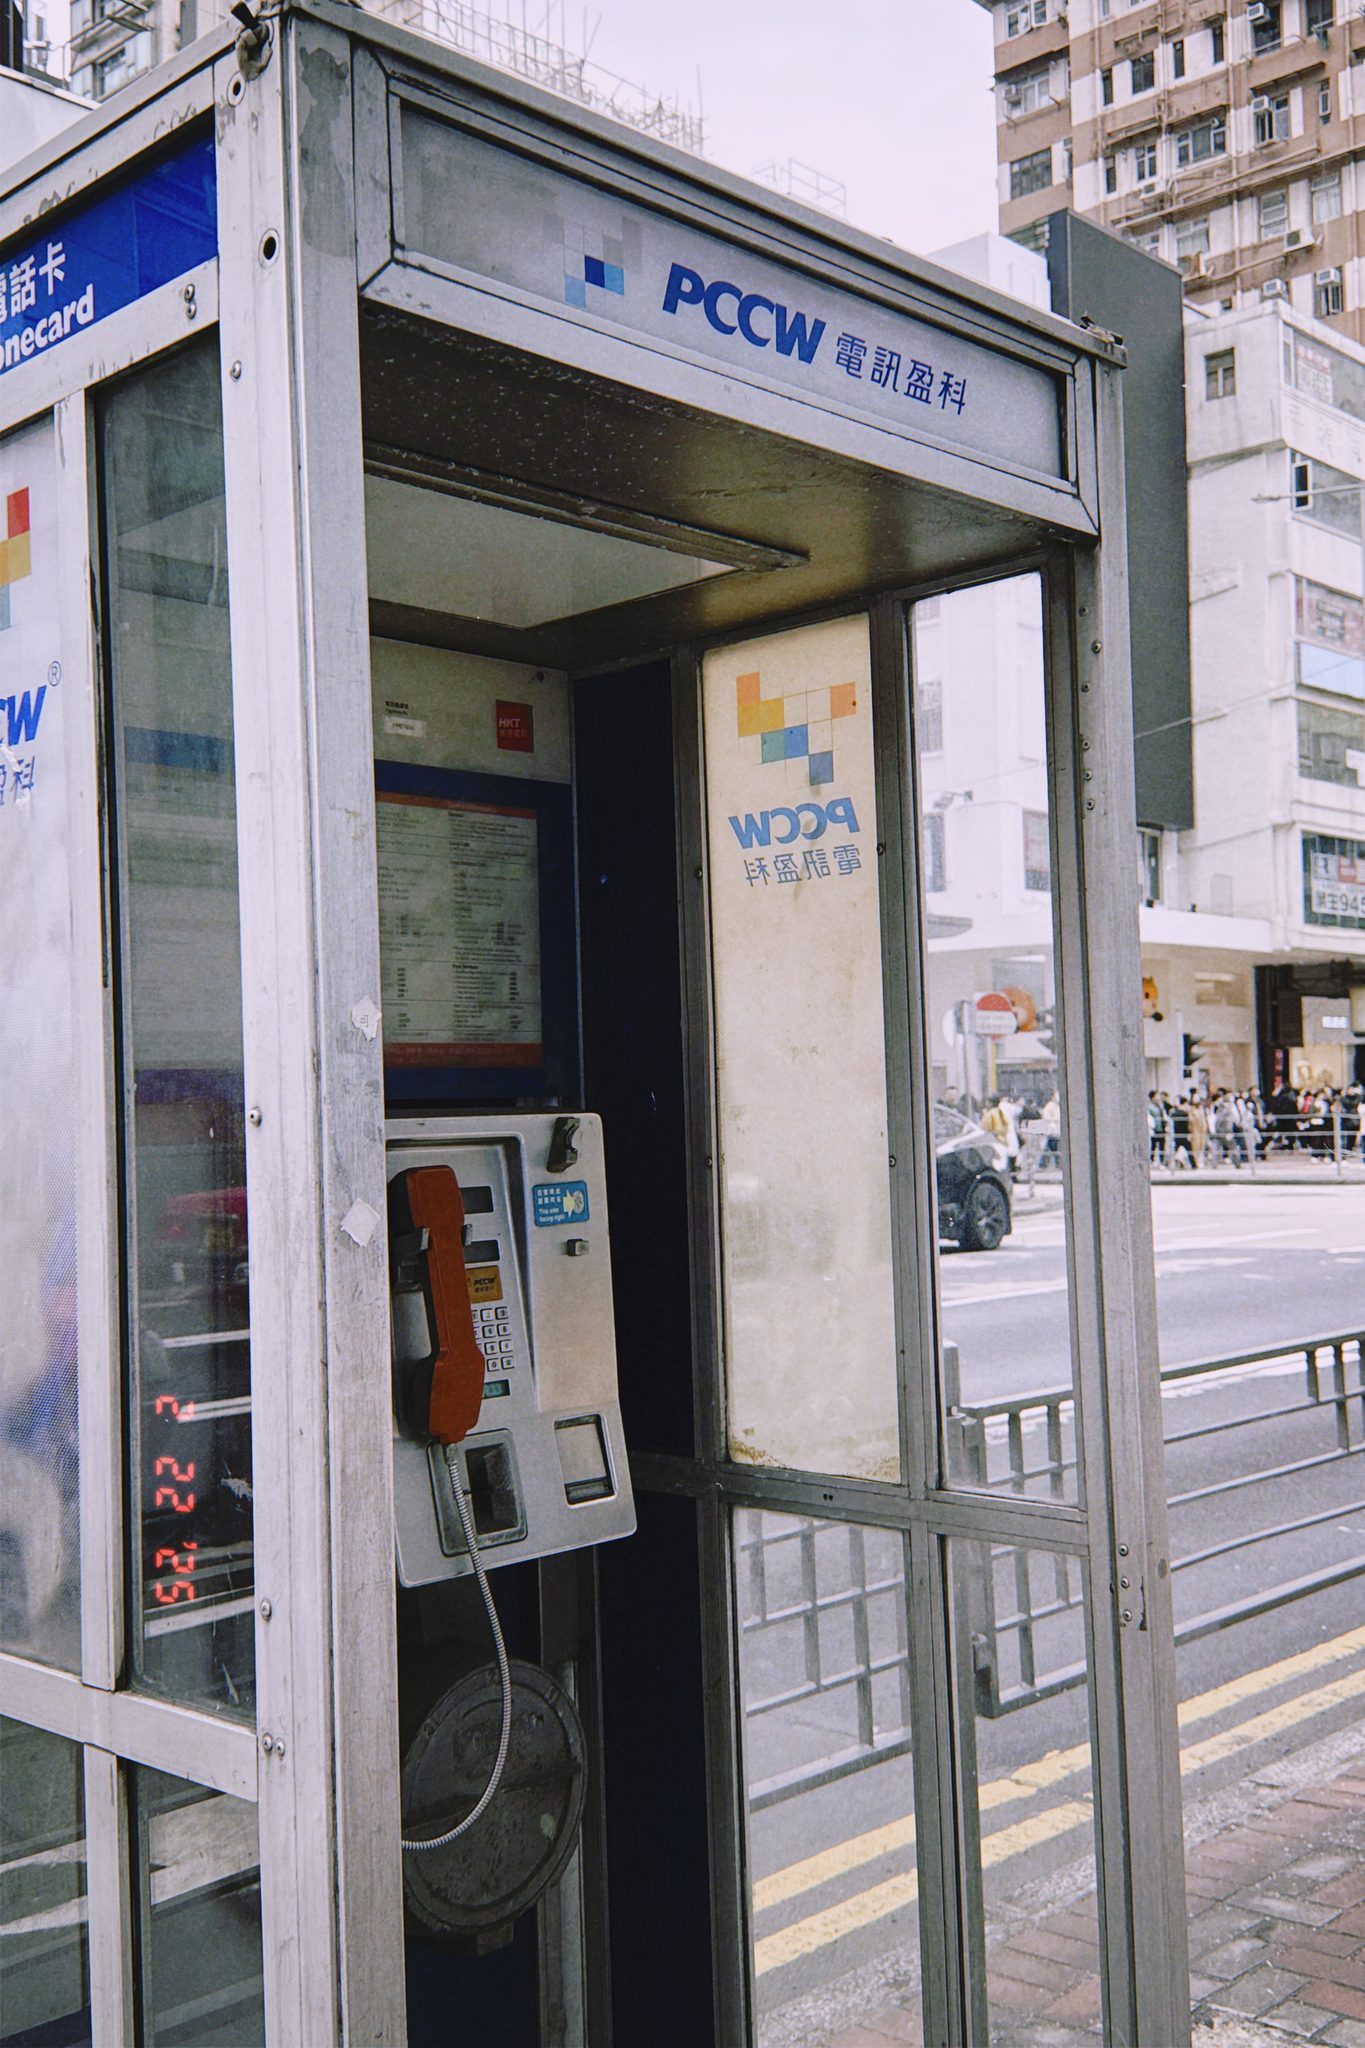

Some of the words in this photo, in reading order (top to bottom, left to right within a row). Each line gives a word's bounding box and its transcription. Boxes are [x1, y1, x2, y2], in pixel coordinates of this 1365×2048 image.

[0, 242, 66, 324] 話卡
[662, 262, 826, 364] PCCW
[836, 331, 967, 415] 電訊盈科
[0, 685, 47, 747] W
